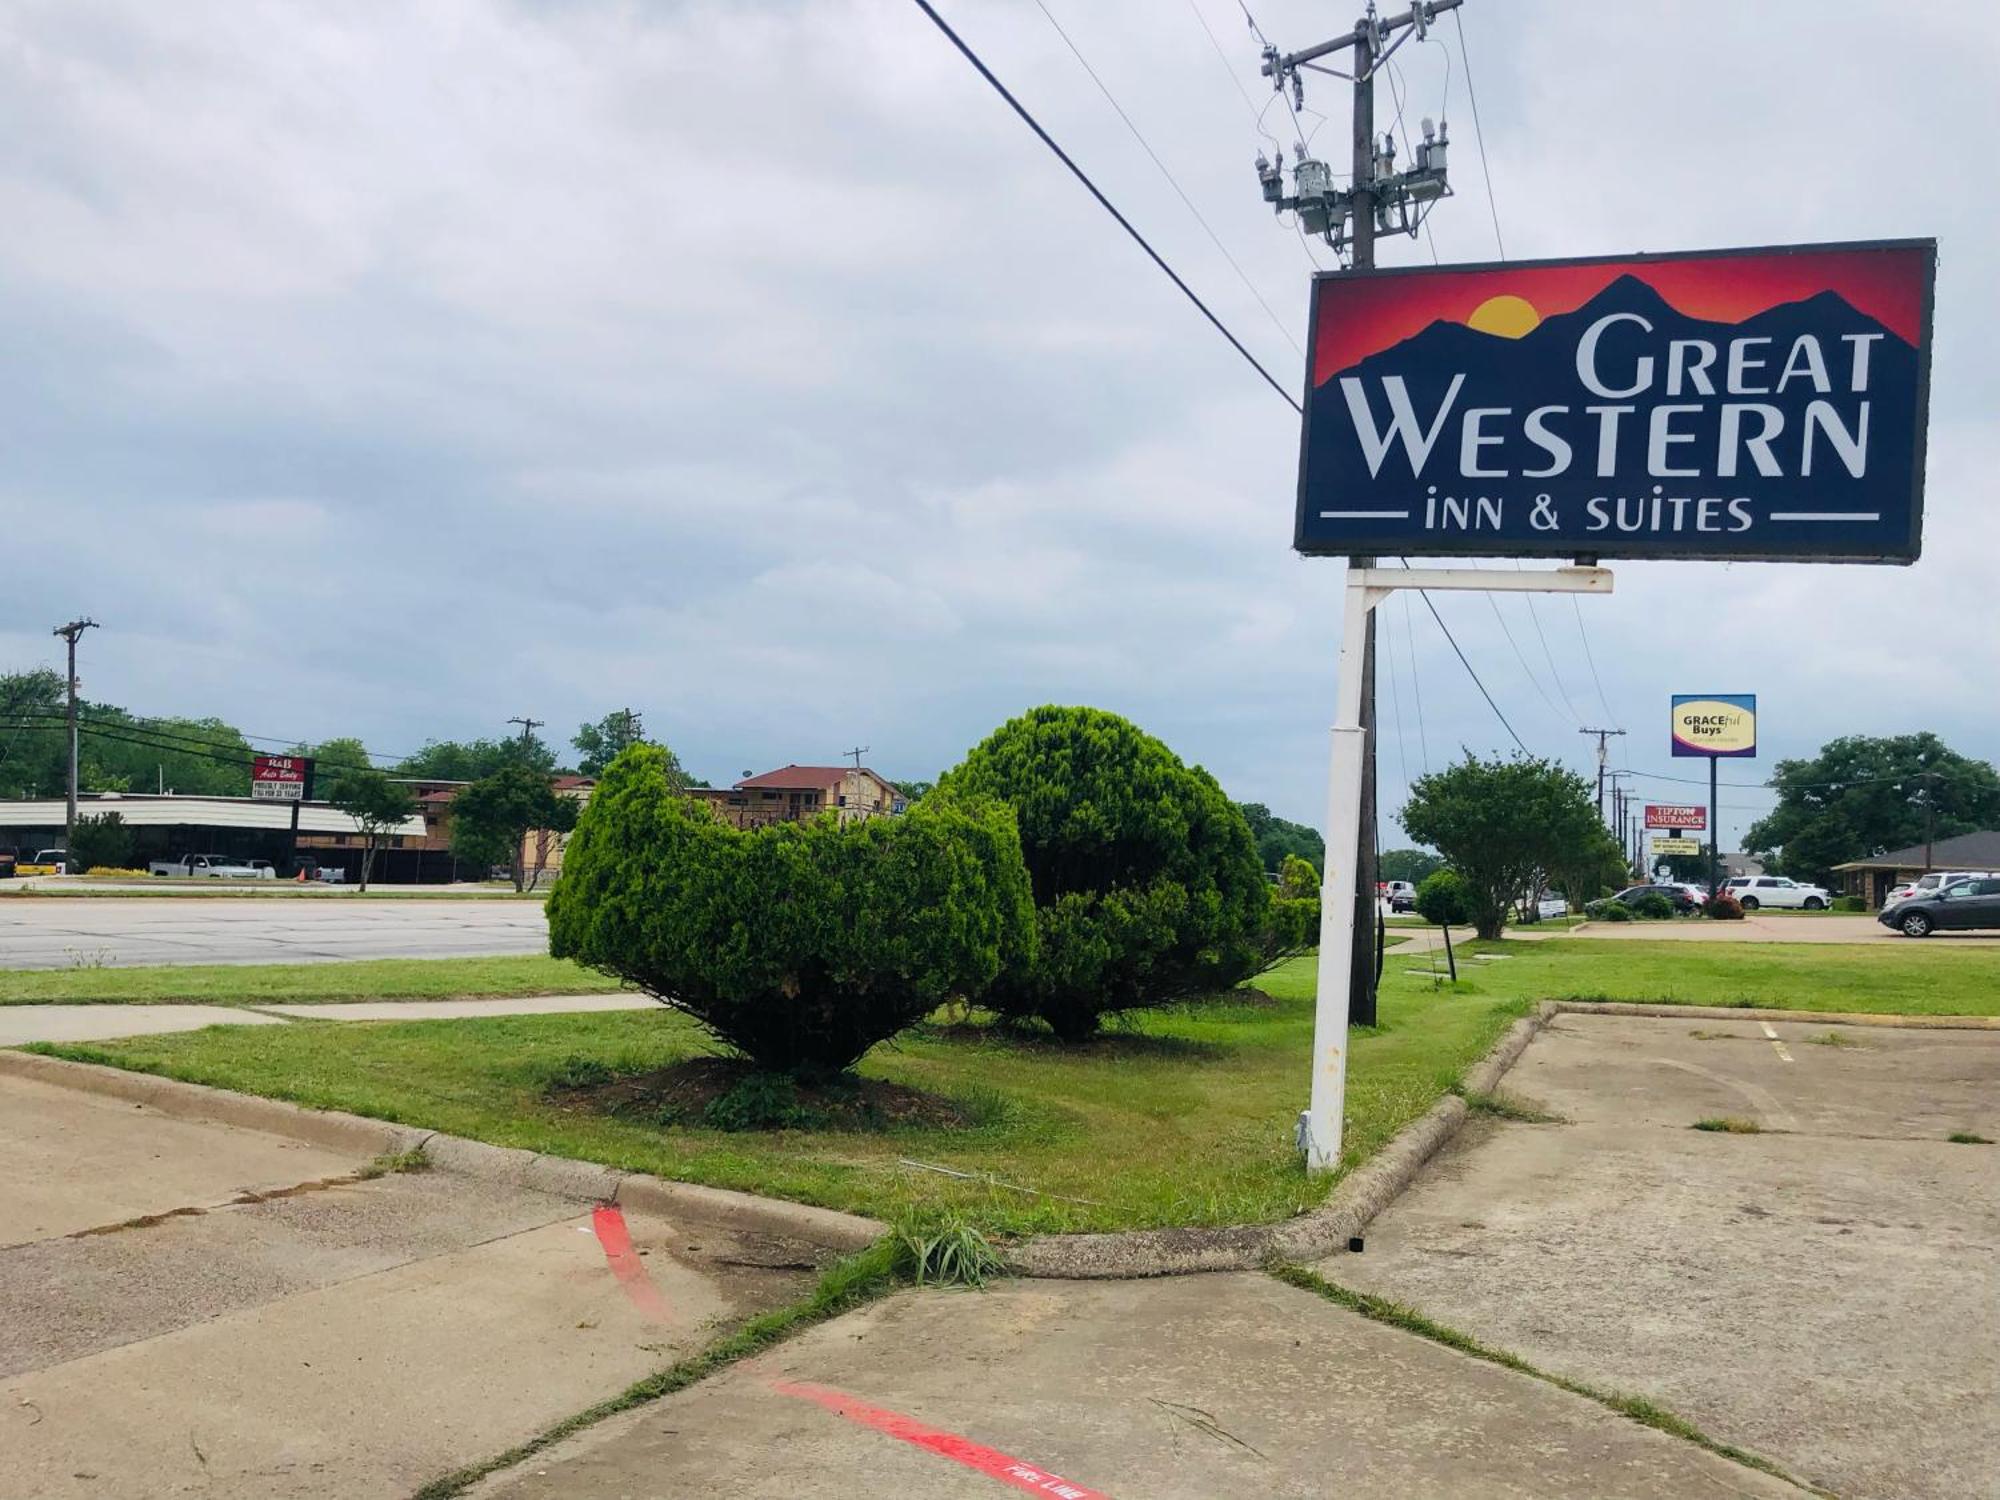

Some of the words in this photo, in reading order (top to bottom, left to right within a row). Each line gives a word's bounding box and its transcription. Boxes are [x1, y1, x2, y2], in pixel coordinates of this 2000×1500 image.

[1576, 312, 1884, 399] GREAT
[1339, 372, 1871, 480] WESTERN
[1529, 493, 1560, 532] &
[1692, 725, 1722, 736] Buys
[1647, 815, 1704, 824] INSURANCE
